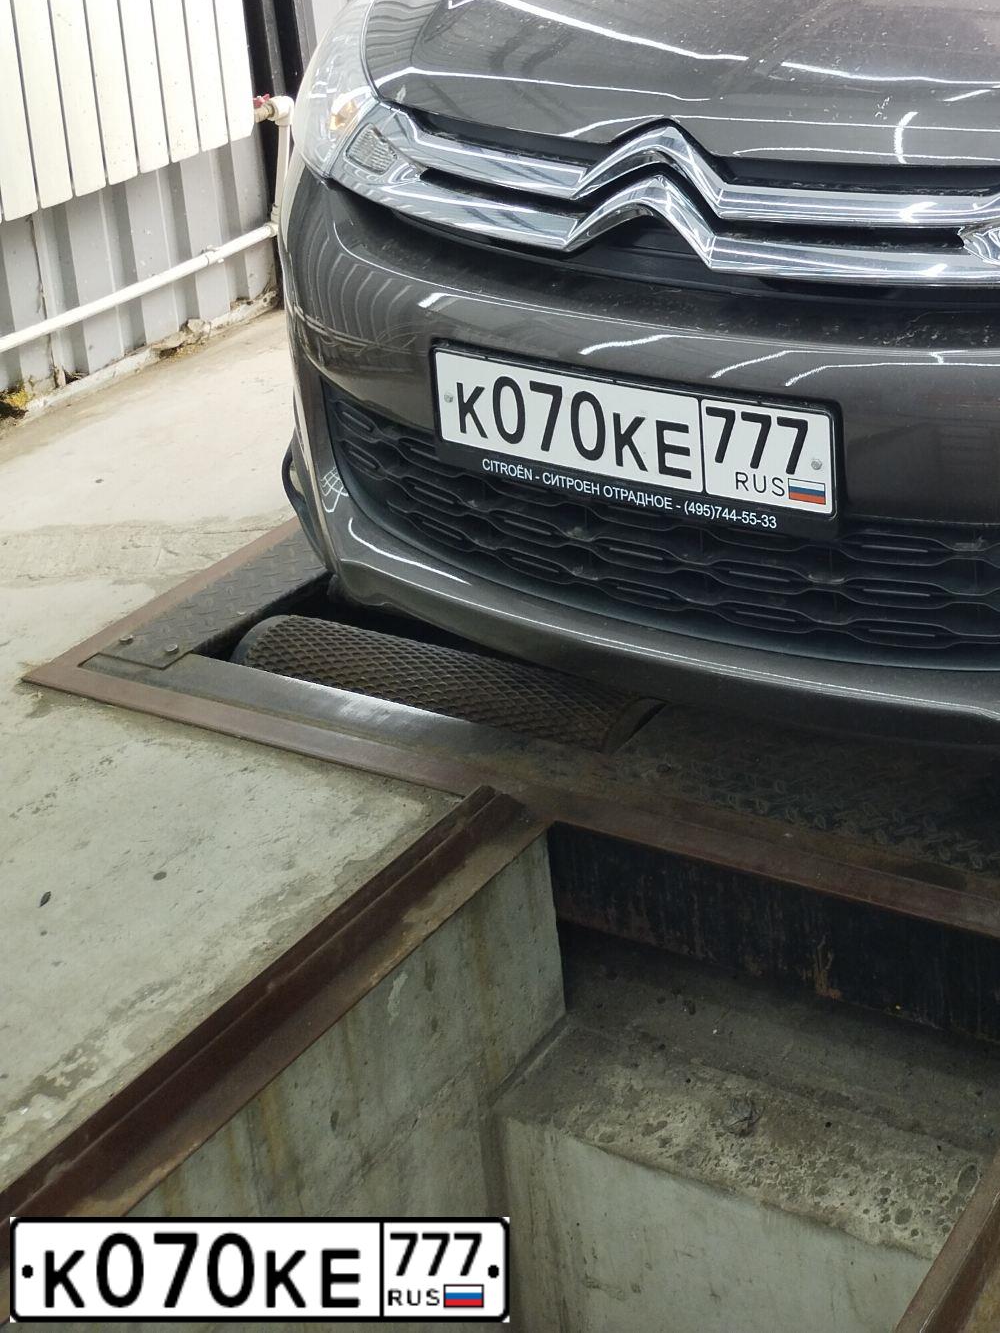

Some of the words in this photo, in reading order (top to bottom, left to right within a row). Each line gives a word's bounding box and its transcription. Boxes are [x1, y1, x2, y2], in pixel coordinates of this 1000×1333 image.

[456, 376, 692, 479] К070КЕ
[705, 406, 809, 475] 777
[482, 457, 532, 481] CITROËN
[542, 472, 599, 496] СИТРОЕН
[603, 484, 673, 510] ОТРАДНОЕ
[684, 500, 777, 529] (495)744-55-33
[735, 471, 785, 497] RUS
